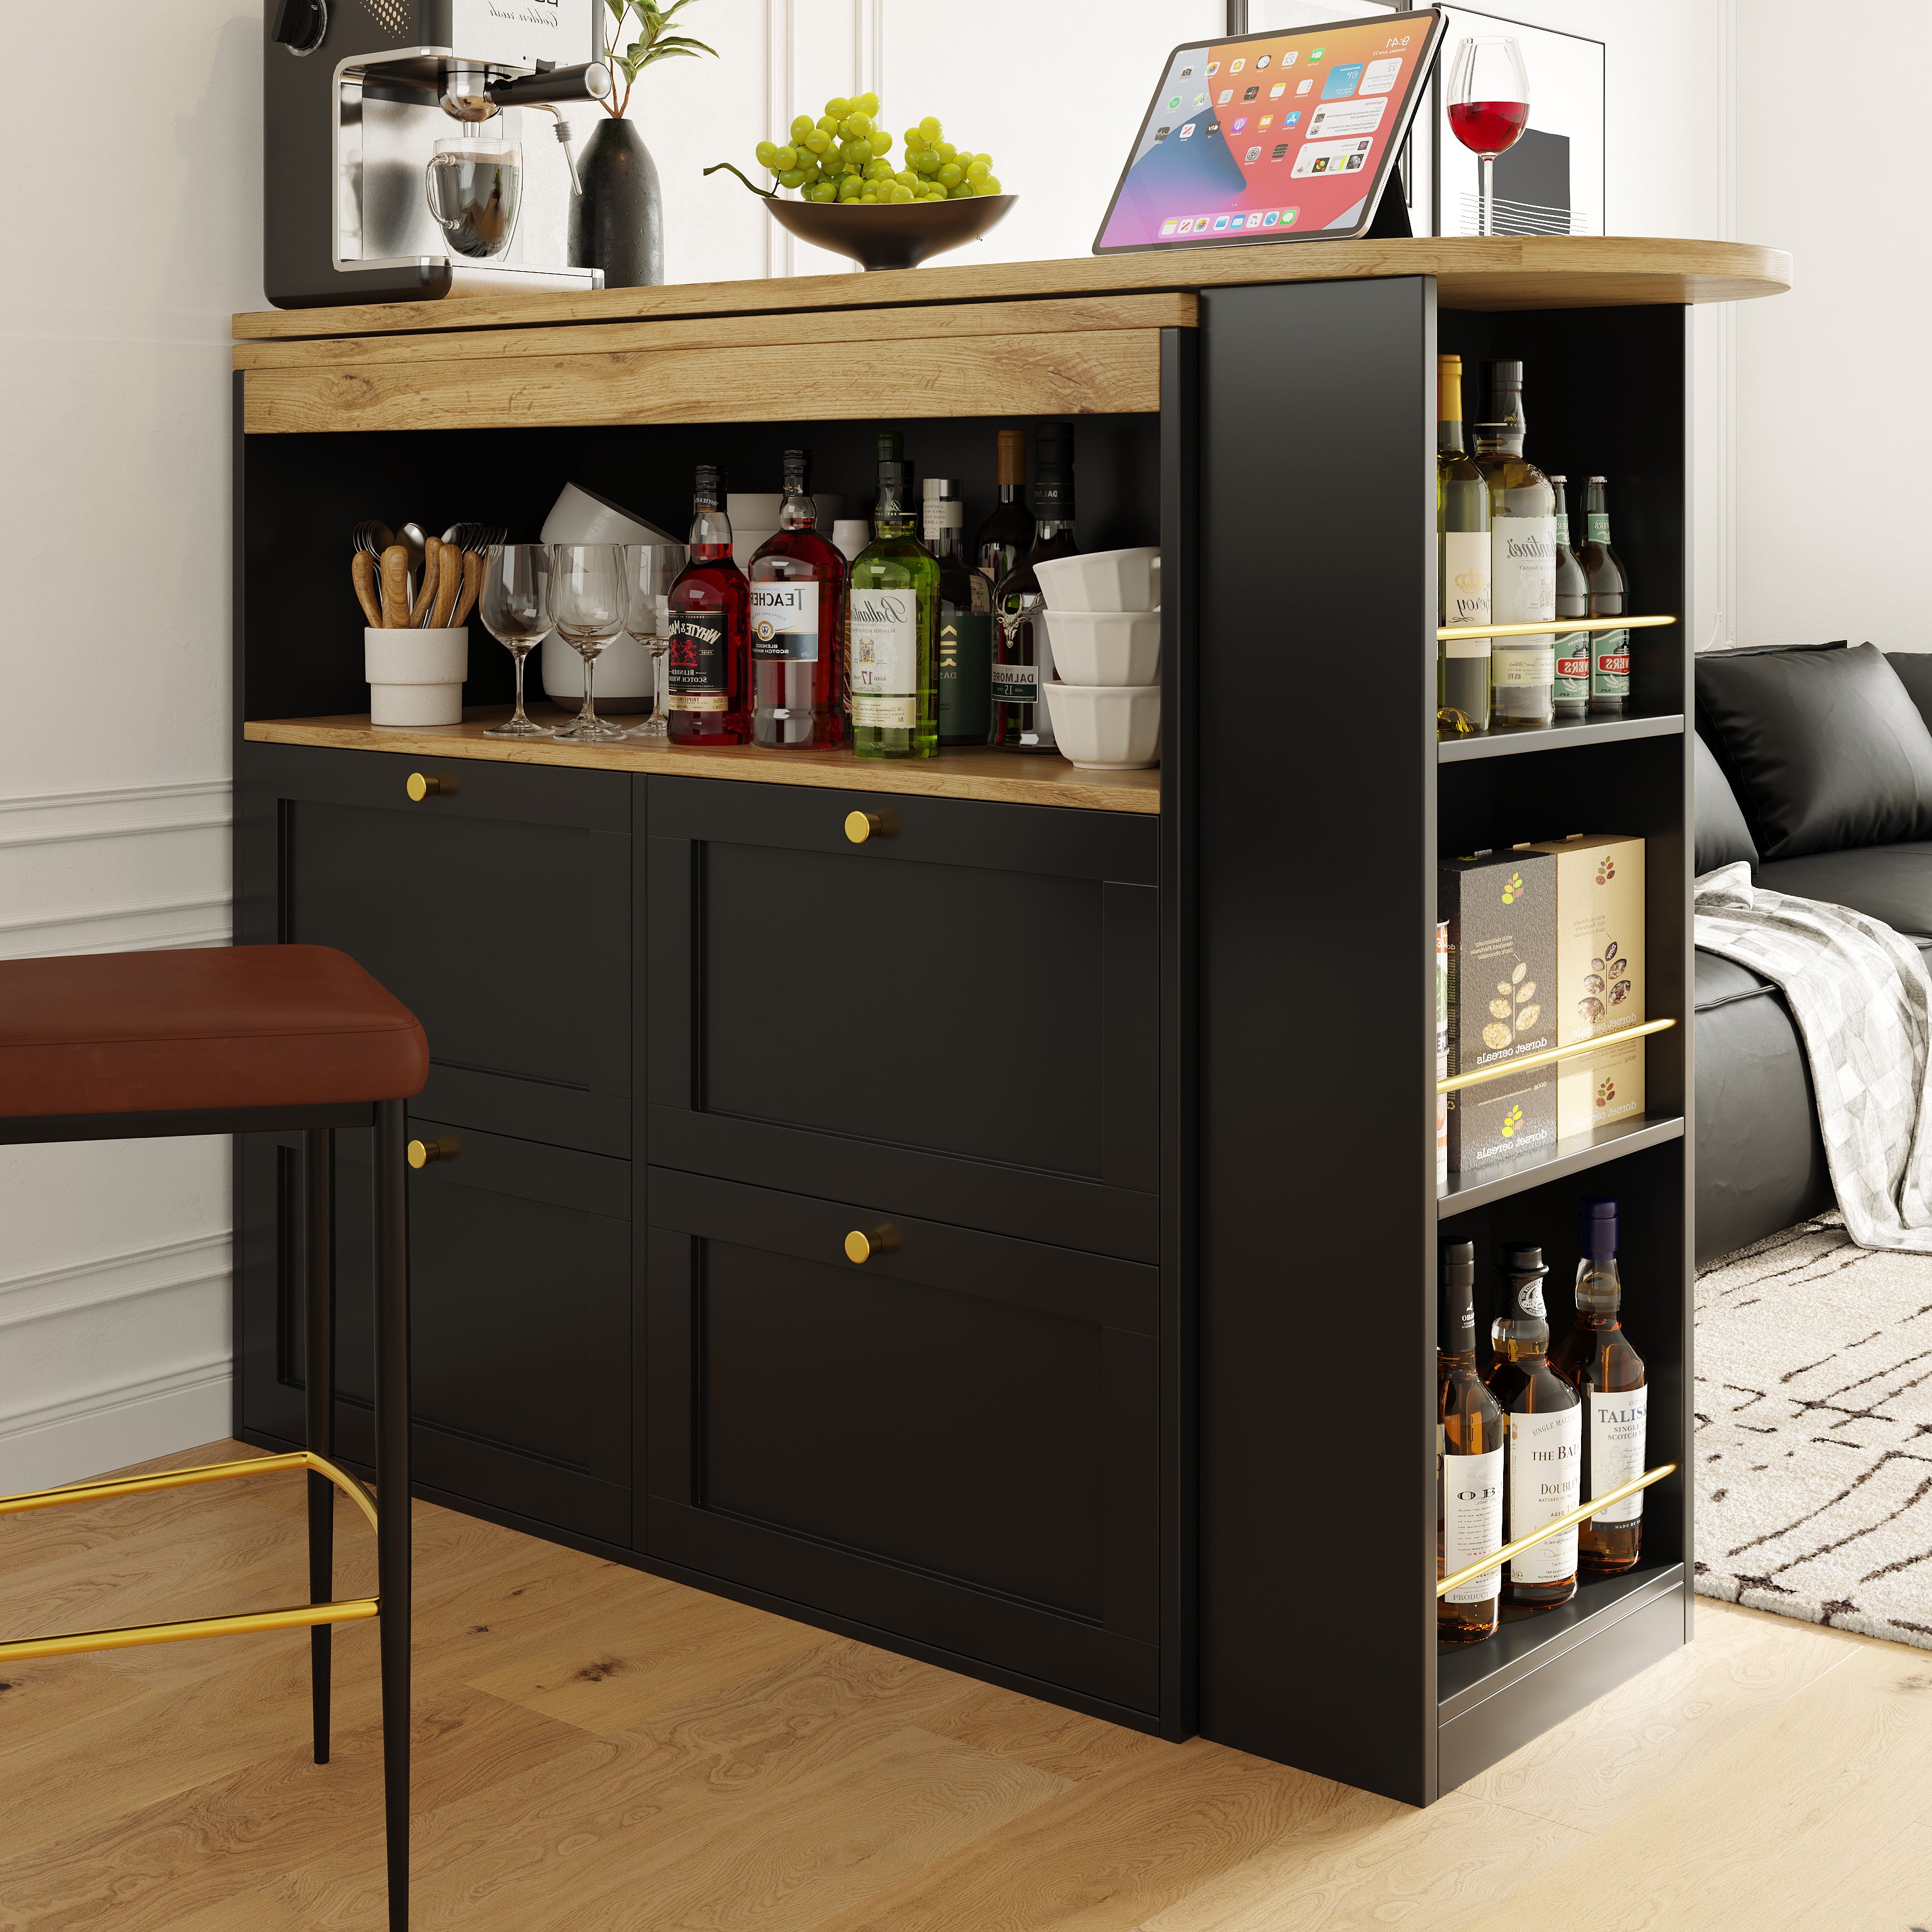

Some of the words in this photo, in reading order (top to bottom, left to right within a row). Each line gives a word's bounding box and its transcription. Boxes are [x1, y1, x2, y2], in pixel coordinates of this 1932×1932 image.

[1532, 1422, 1555, 1437] SINGLE
[1556, 1417, 1571, 1426] MALT
[1614, 1423, 1640, 1433] SINGLE
[1607, 1431, 1637, 1441] SCOTCH
[1531, 1451, 1554, 1461] THE
[1453, 1592, 1489, 1601] PRODUCT
